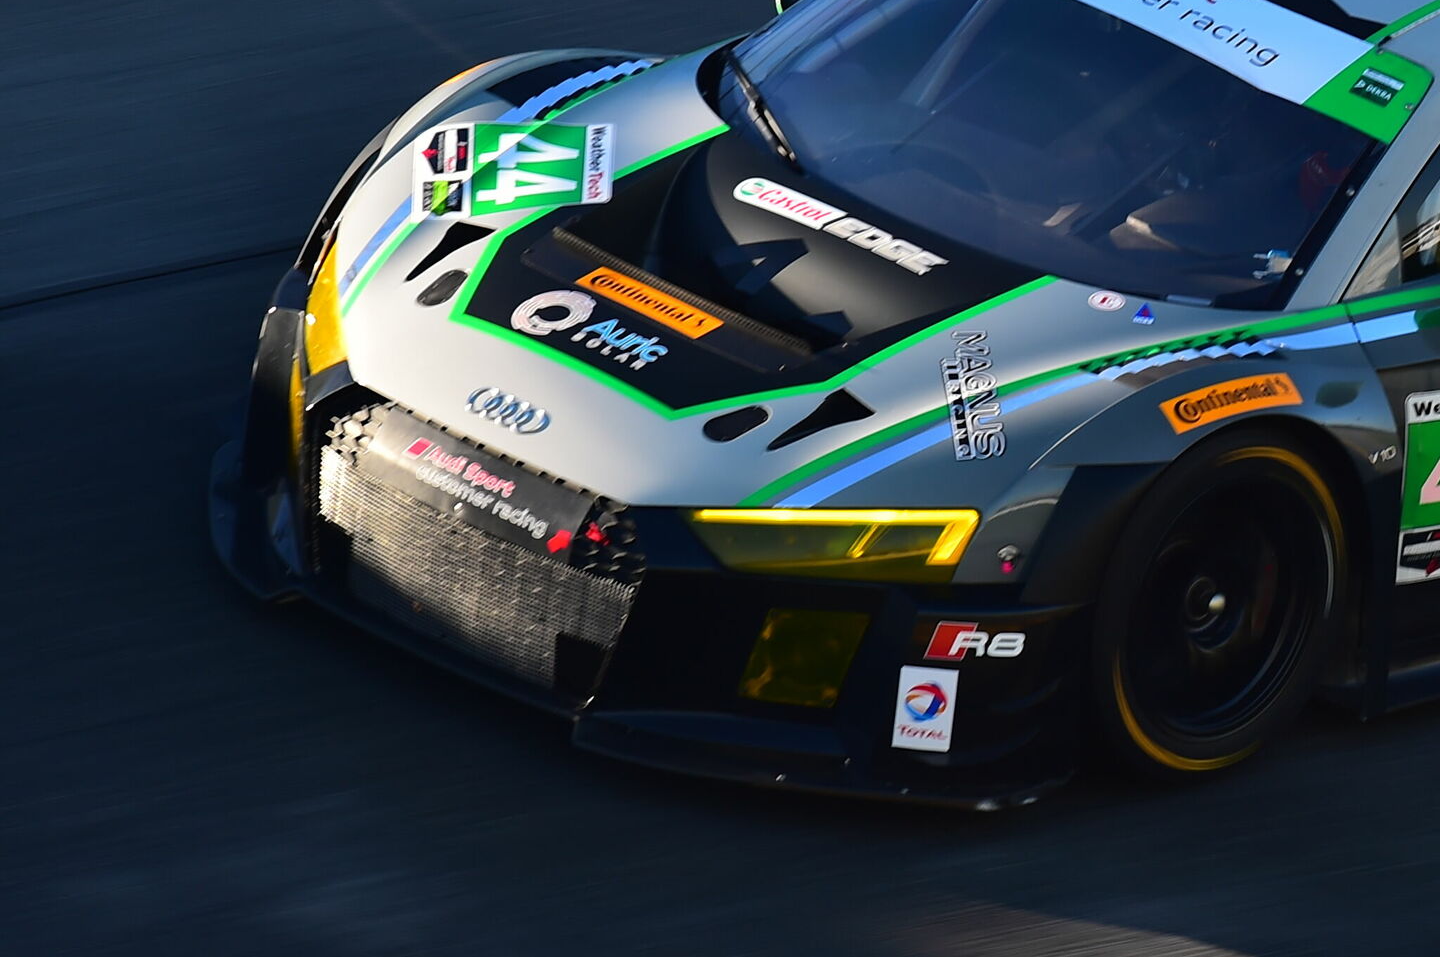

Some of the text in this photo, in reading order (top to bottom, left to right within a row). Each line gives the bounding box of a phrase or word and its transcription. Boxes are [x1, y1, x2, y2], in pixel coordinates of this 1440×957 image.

[1179, 8, 1281, 68] racing
[476, 133, 580, 205] 44
[587, 125, 608, 200] WeatherTech
[757, 188, 950, 276] Castrol EDGE
[589, 274, 694, 322] Continental
[581, 318, 669, 363] Auric
[951, 330, 1006, 460] MAGNUS
[1173, 383, 1274, 424] Continental
[416, 465, 550, 539] customer racing
[424, 446, 516, 498] Audi Sport
[948, 631, 1026, 658] R8
